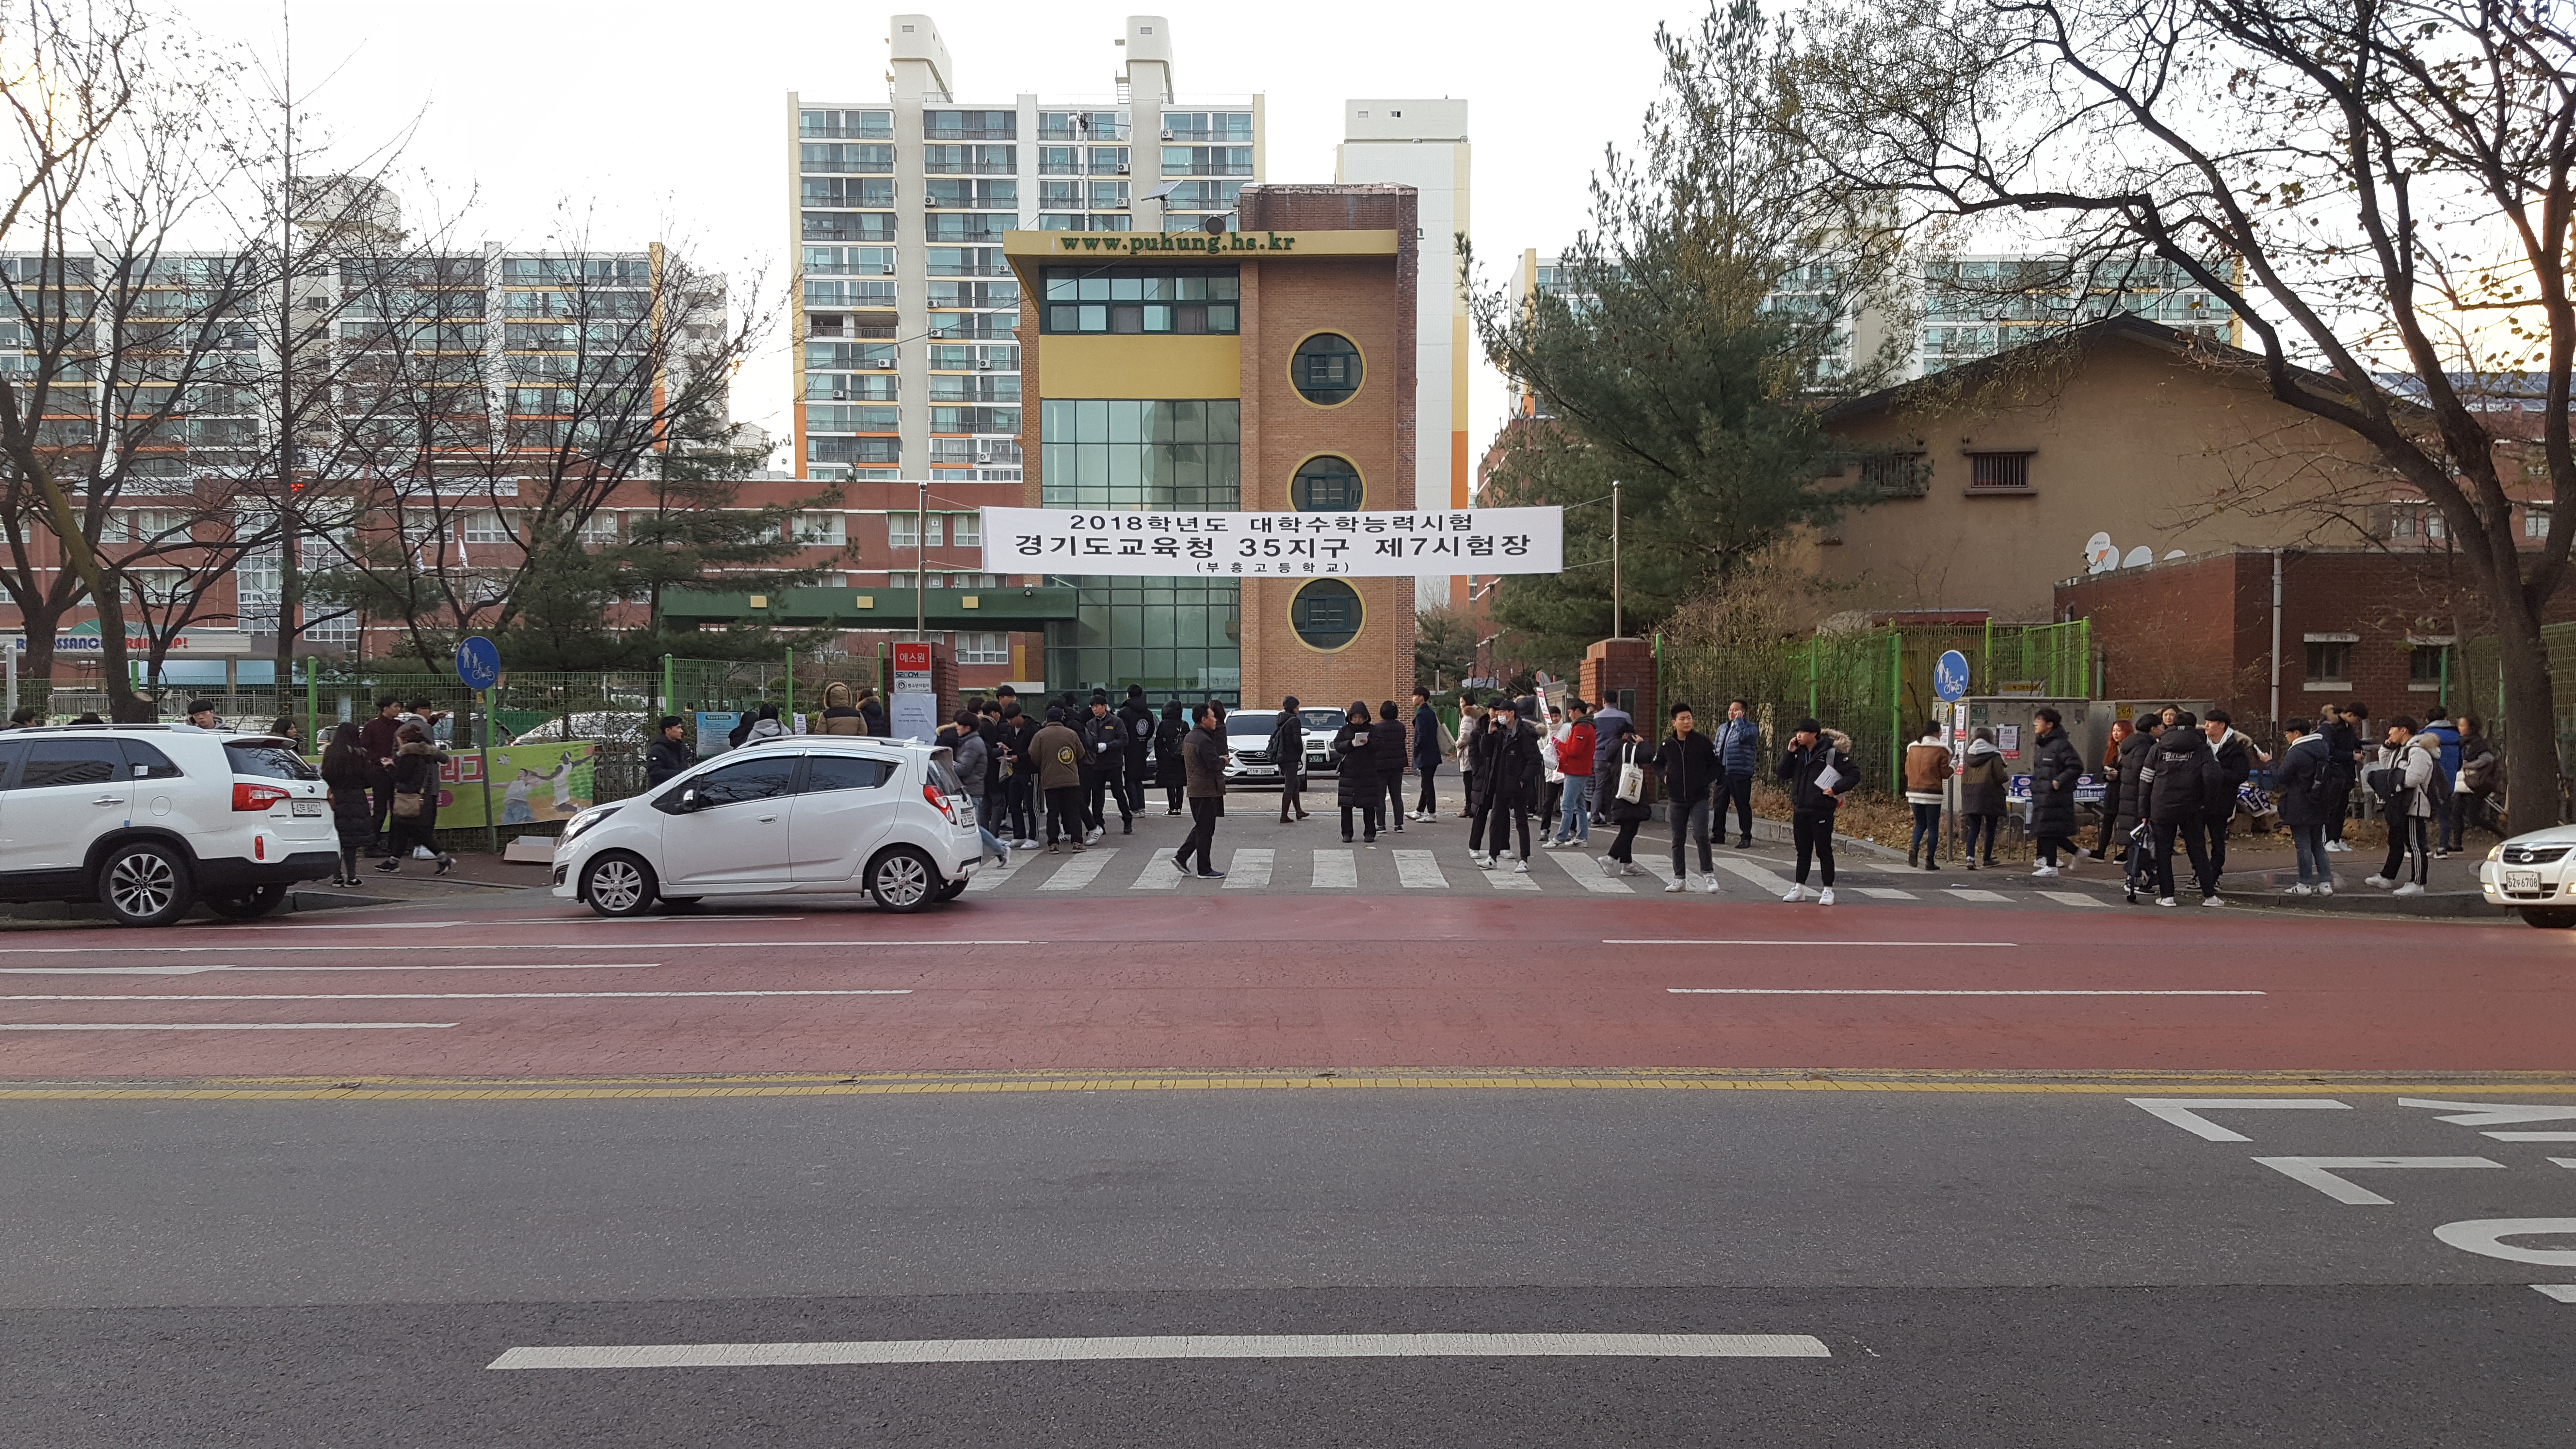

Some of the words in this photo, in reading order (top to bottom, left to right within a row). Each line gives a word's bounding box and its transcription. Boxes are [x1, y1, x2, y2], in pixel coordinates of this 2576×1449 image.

[1061, 232, 1295, 254] www.puhung.hs.kr
[1070, 515, 1229, 532] 2018학년도
[1250, 514, 1472, 533] 대학수학능력시험
[1015, 535, 1213, 558] 경기도교육청
[1239, 538, 1350, 558] 35지구
[1374, 534, 1531, 558] 제7시험장
[16, 638, 103, 649] RSSANC
[899, 652, 925, 663] 에스원
